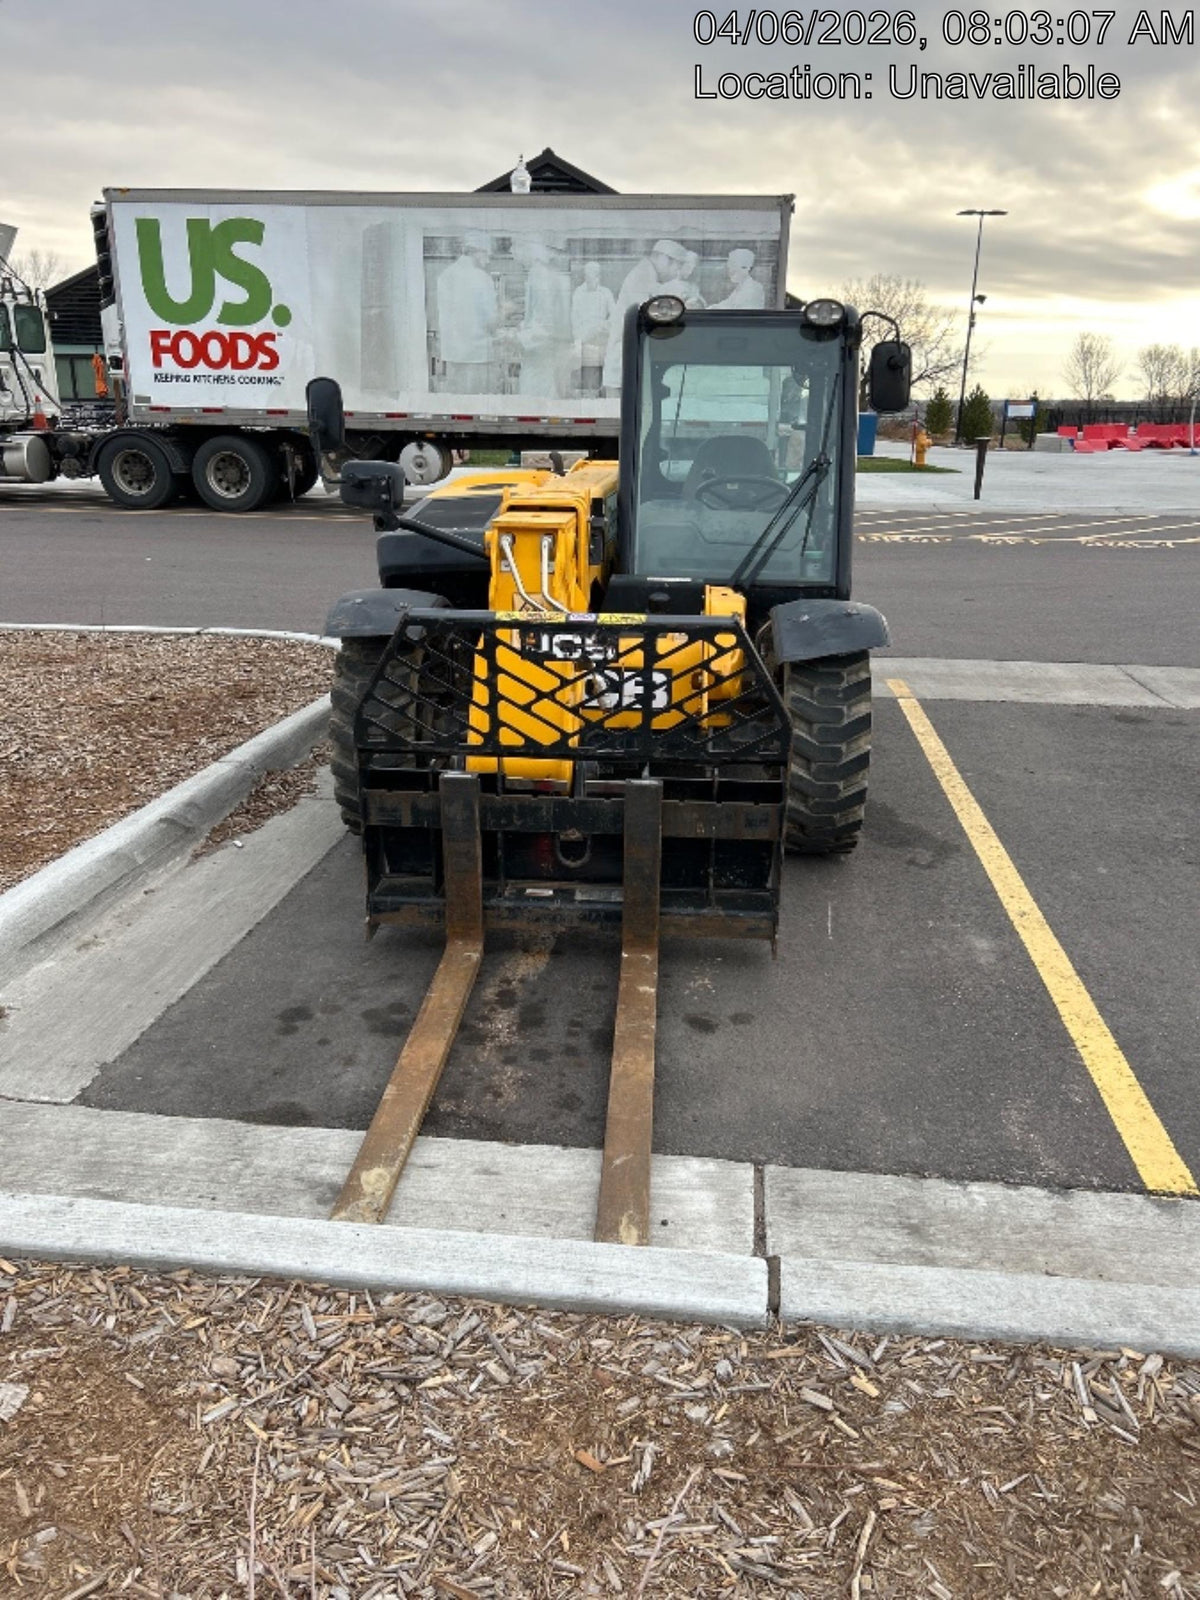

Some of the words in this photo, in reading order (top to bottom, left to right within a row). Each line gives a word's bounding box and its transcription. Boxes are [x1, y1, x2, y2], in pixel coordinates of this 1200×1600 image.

[149, 330, 280, 371] FOODS
[154, 373, 191, 384] KEEPING
[193, 374, 236, 385] KITCHENS
